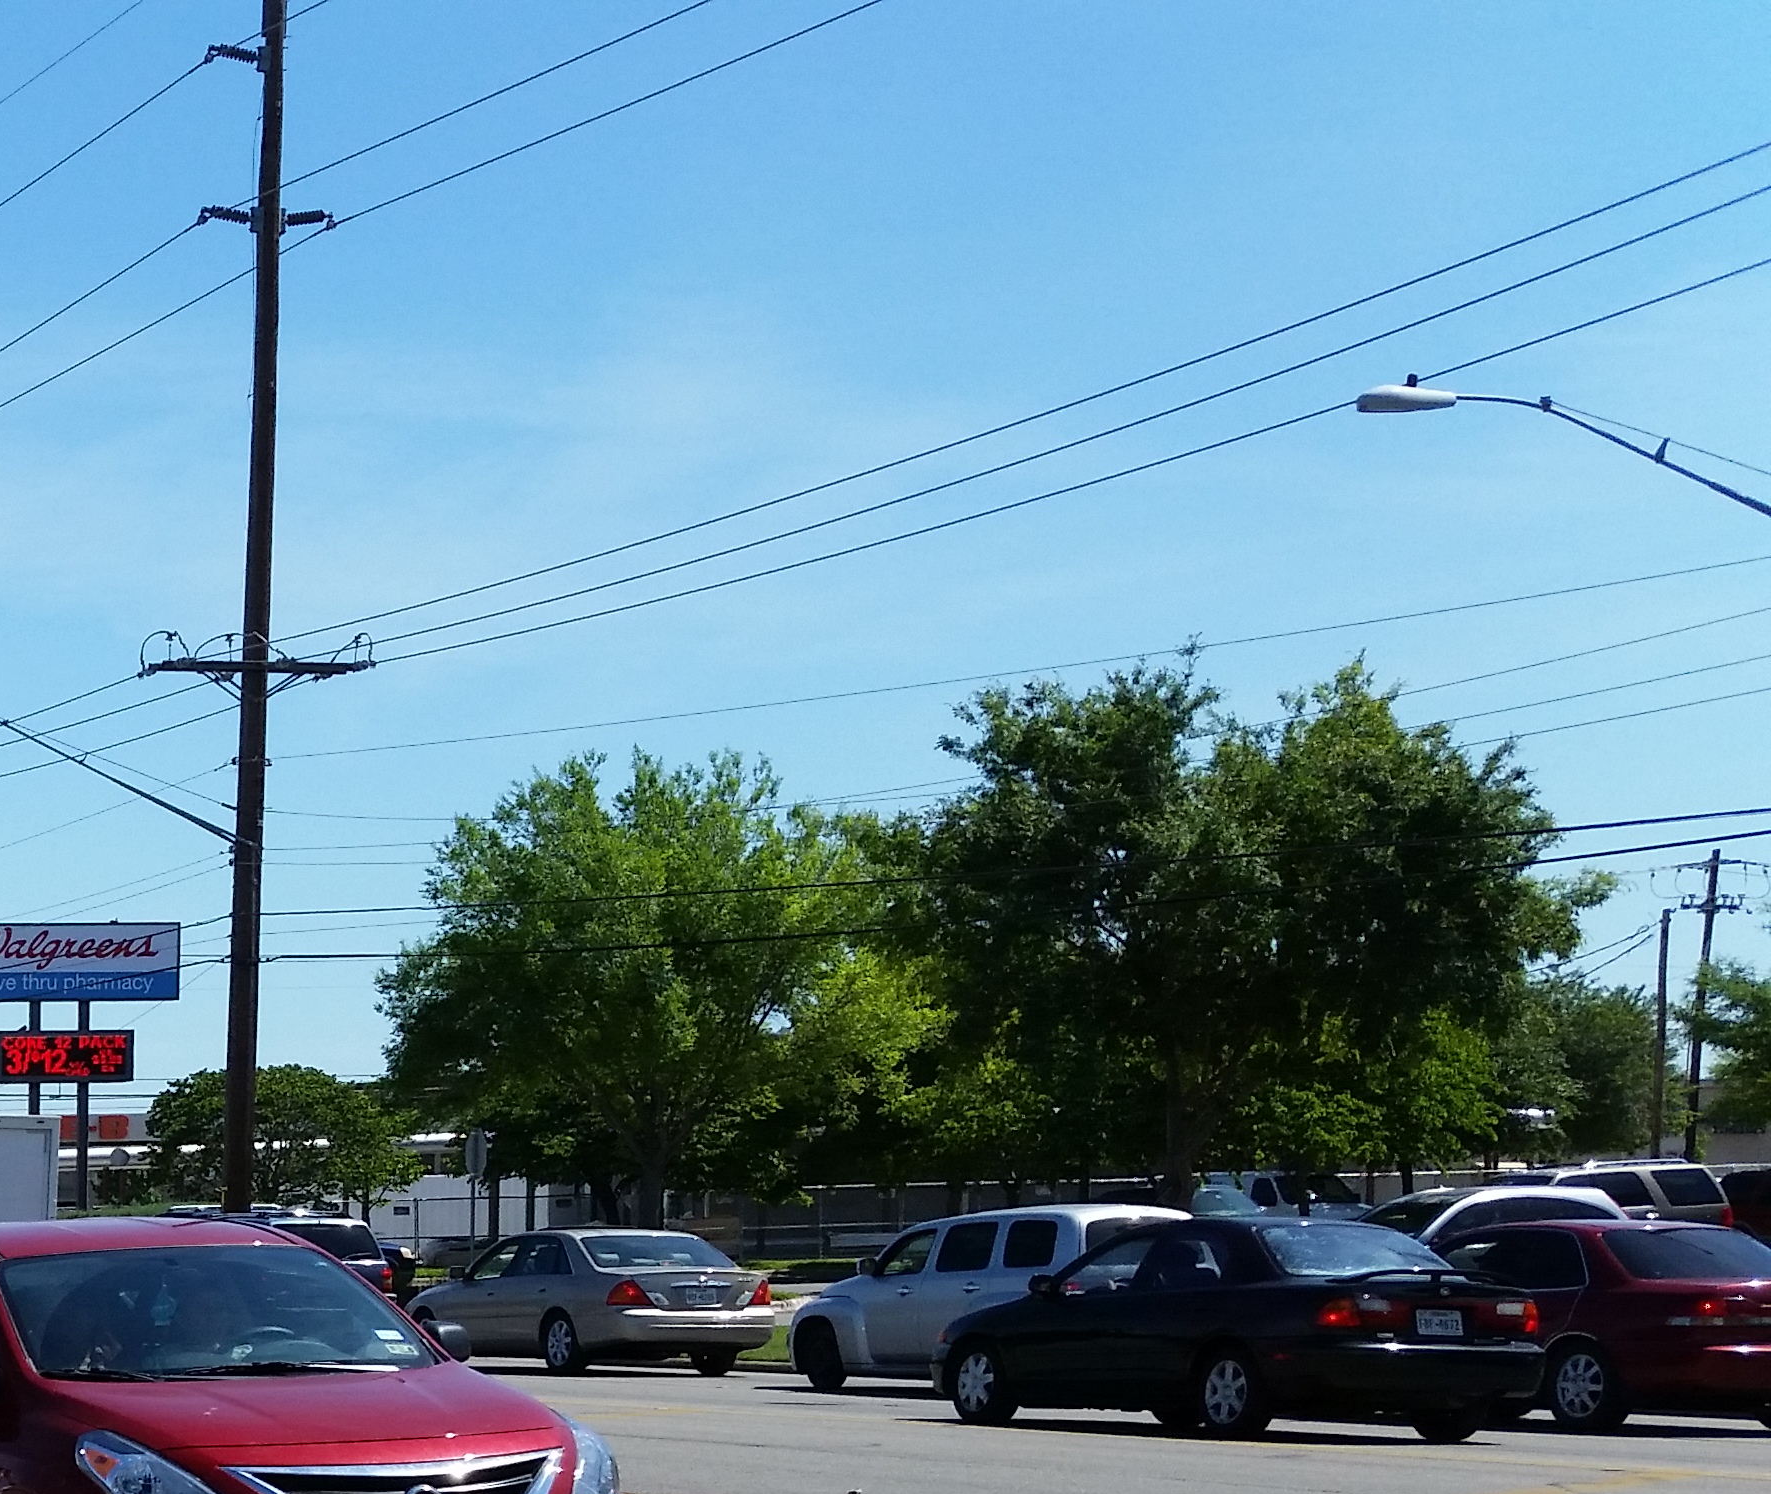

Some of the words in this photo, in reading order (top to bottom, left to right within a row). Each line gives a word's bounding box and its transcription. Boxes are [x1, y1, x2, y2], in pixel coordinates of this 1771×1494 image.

[22, 974, 58, 991] thru
[63, 974, 154, 994] pharmacy
[55, 1035, 72, 1049] 12
[78, 1035, 127, 1049] PACK
